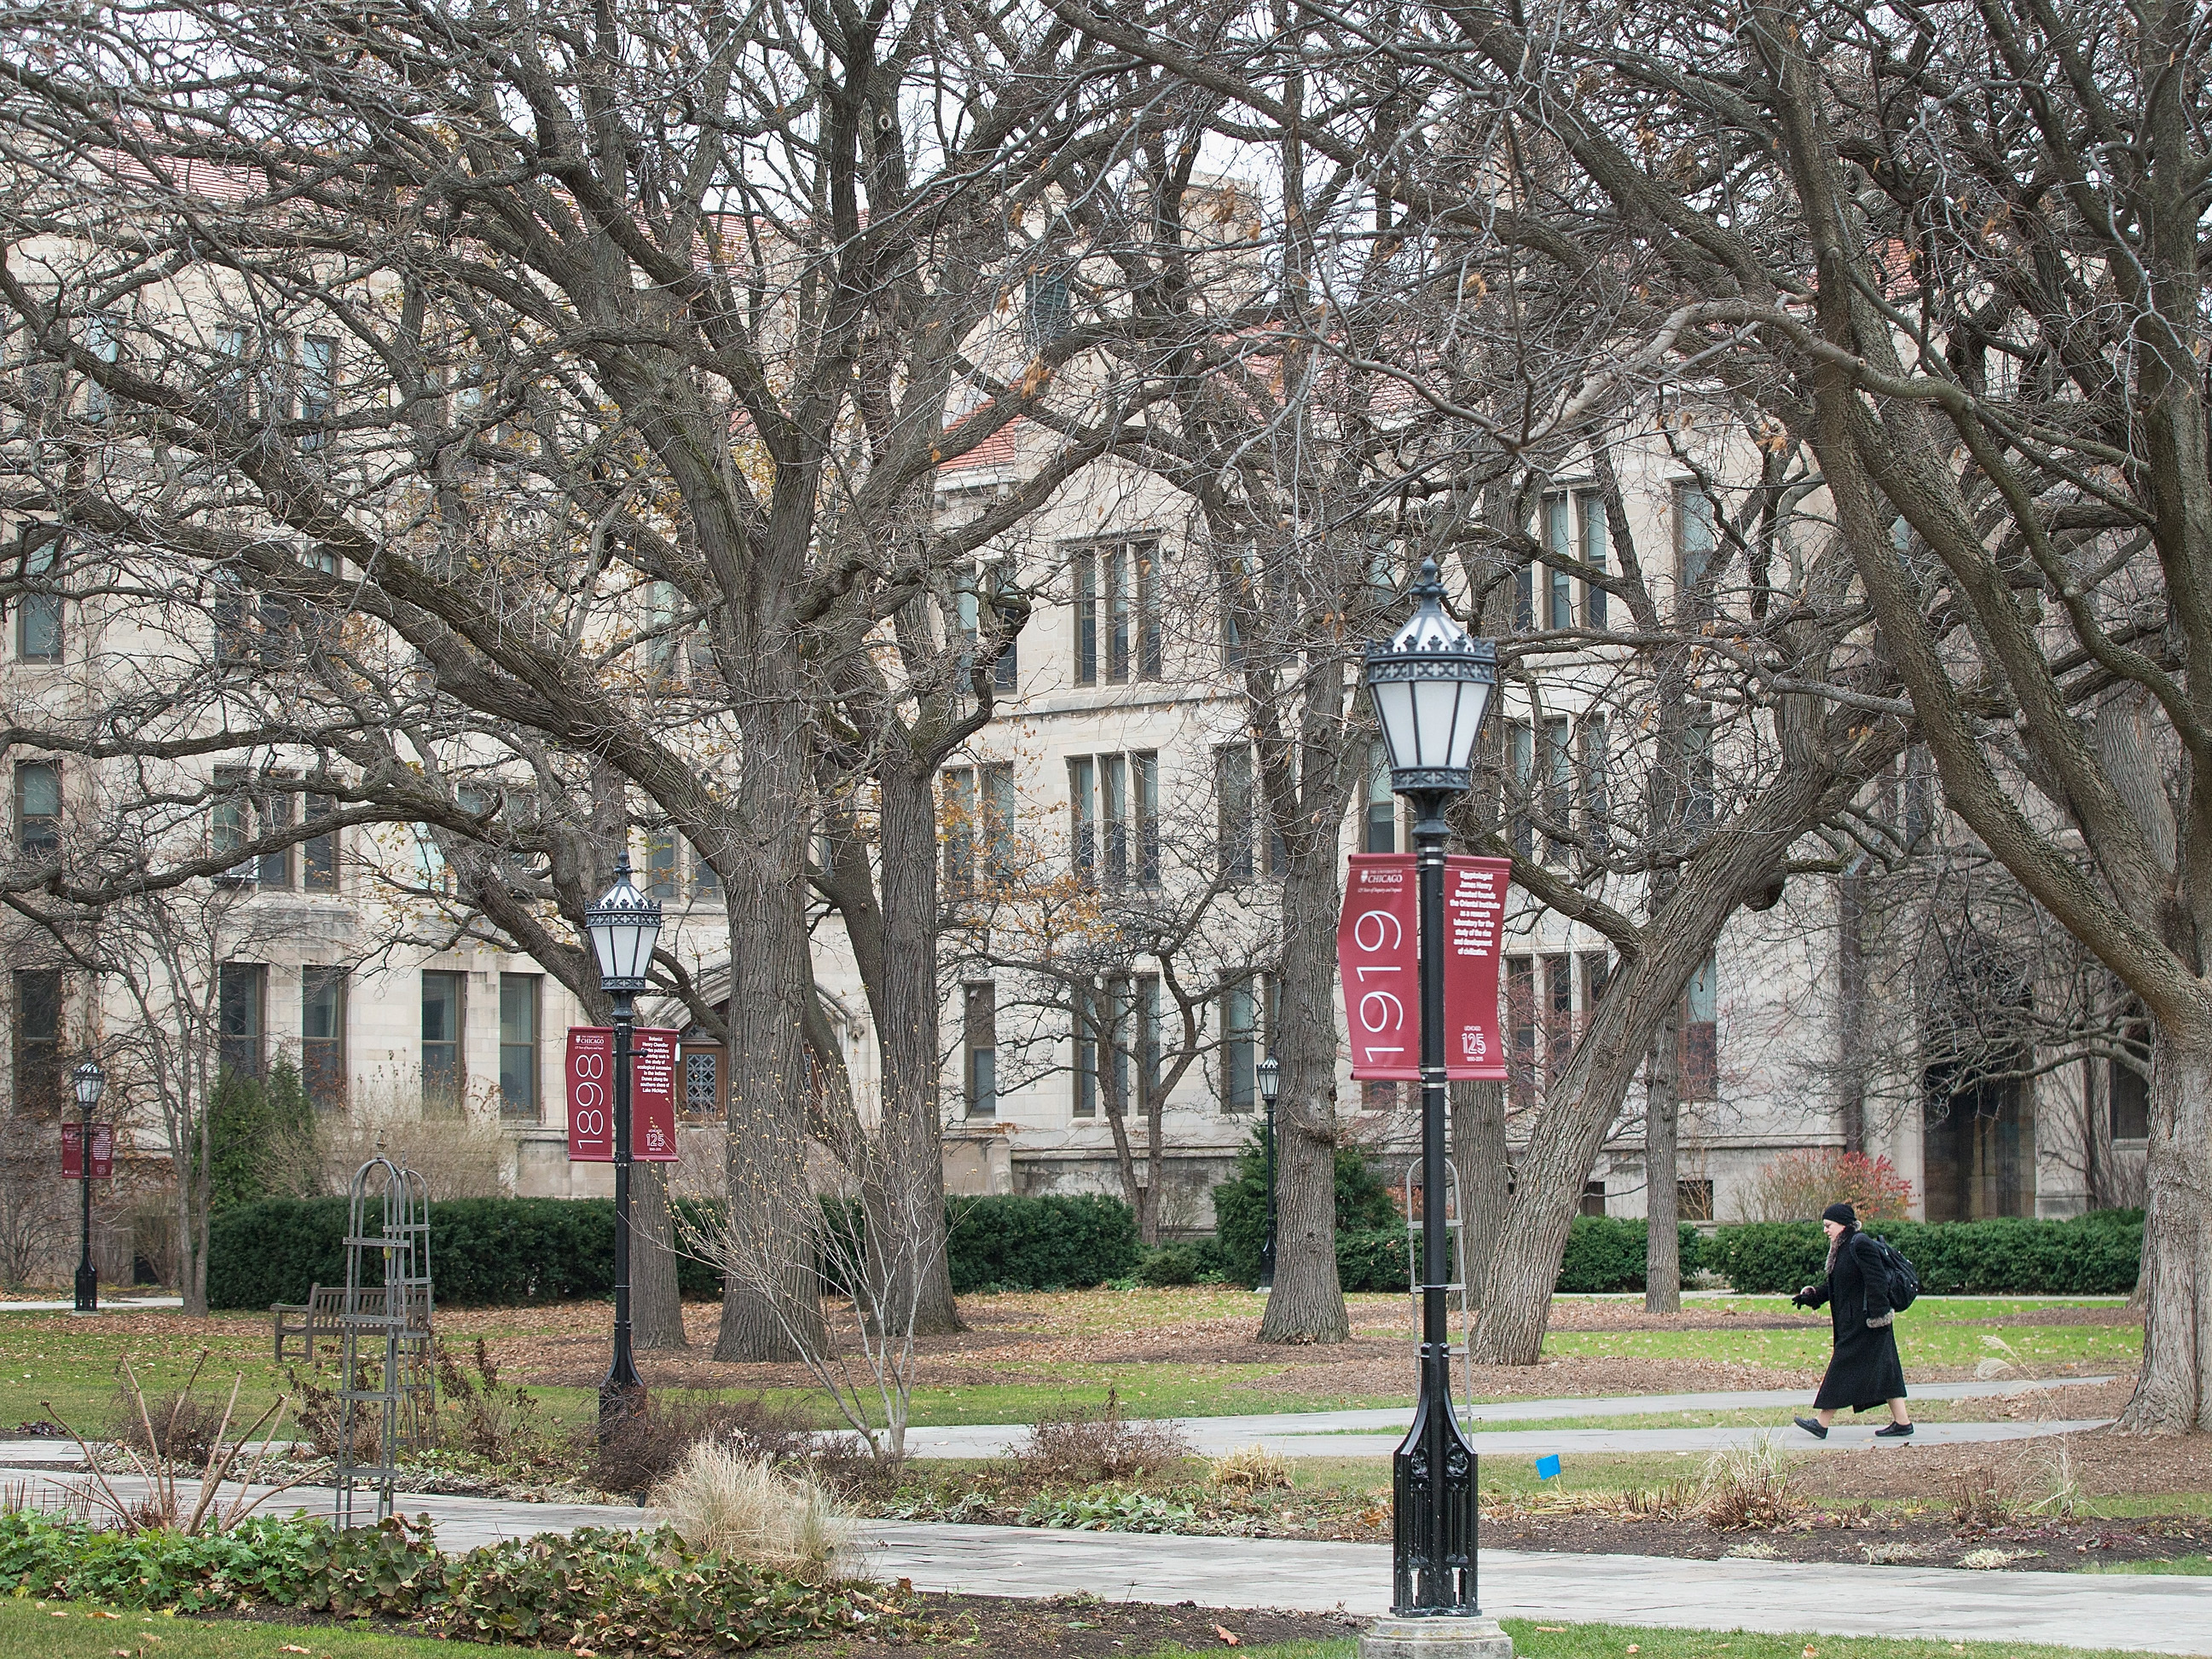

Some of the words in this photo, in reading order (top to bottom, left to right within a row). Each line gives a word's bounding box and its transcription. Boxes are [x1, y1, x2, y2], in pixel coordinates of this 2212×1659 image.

[1368, 874, 1403, 883] CHICAGO
[1460, 870, 1493, 881] Egyptologist
[1477, 882, 1493, 891] Henry
[1455, 889, 1477, 898] Breasted
[1478, 891, 1496, 899] founds
[1459, 899, 1479, 908] Oriental
[1453, 918, 1477, 928] laboratory
[1455, 929, 1469, 937] study
[1464, 938, 1493, 947] development
[1355, 910, 1404, 1062] 1919
[1461, 1033, 1486, 1054] 125
[576, 1053, 603, 1149] 1898
[646, 1133, 665, 1147] 125
